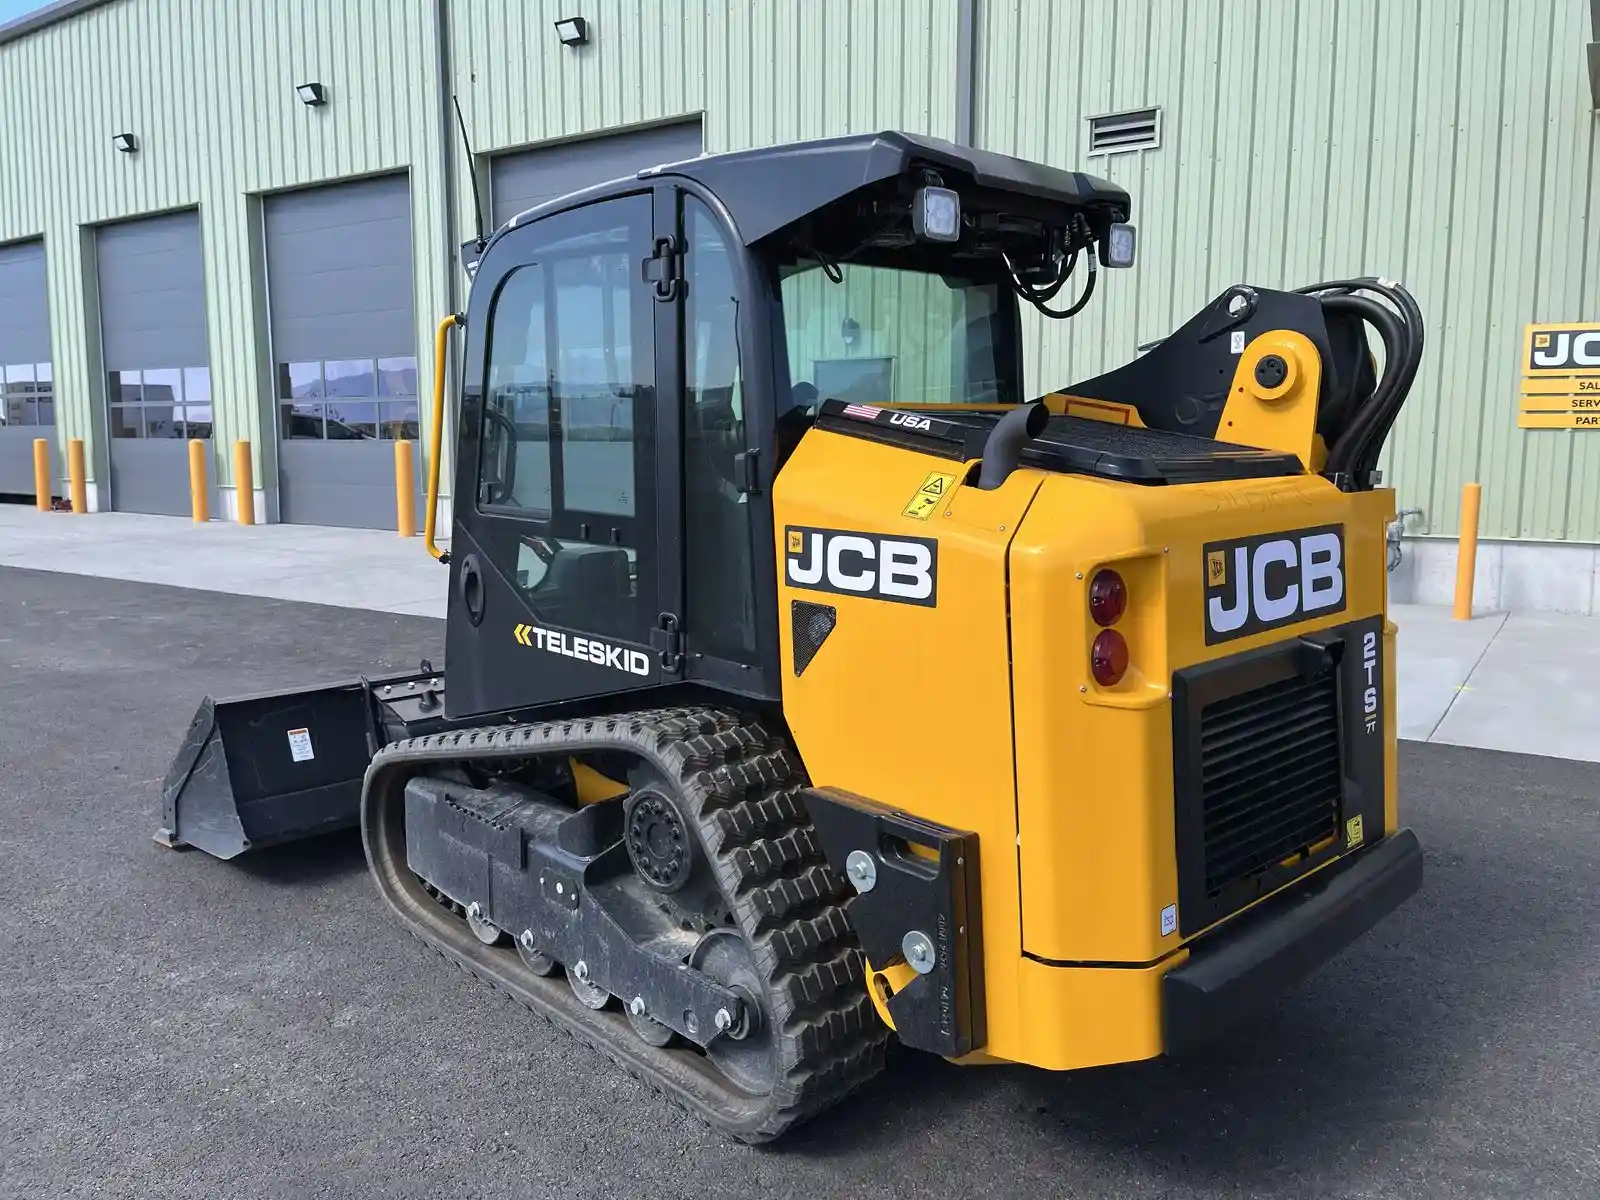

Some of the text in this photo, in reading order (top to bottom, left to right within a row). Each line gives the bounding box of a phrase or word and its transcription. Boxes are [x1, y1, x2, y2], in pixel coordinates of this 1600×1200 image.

[889, 413, 931, 431] USA
[1575, 416, 1600, 425] PAR
[788, 533, 932, 599] JCB
[1209, 533, 1343, 633] JCB
[532, 627, 650, 676] TELESKID
